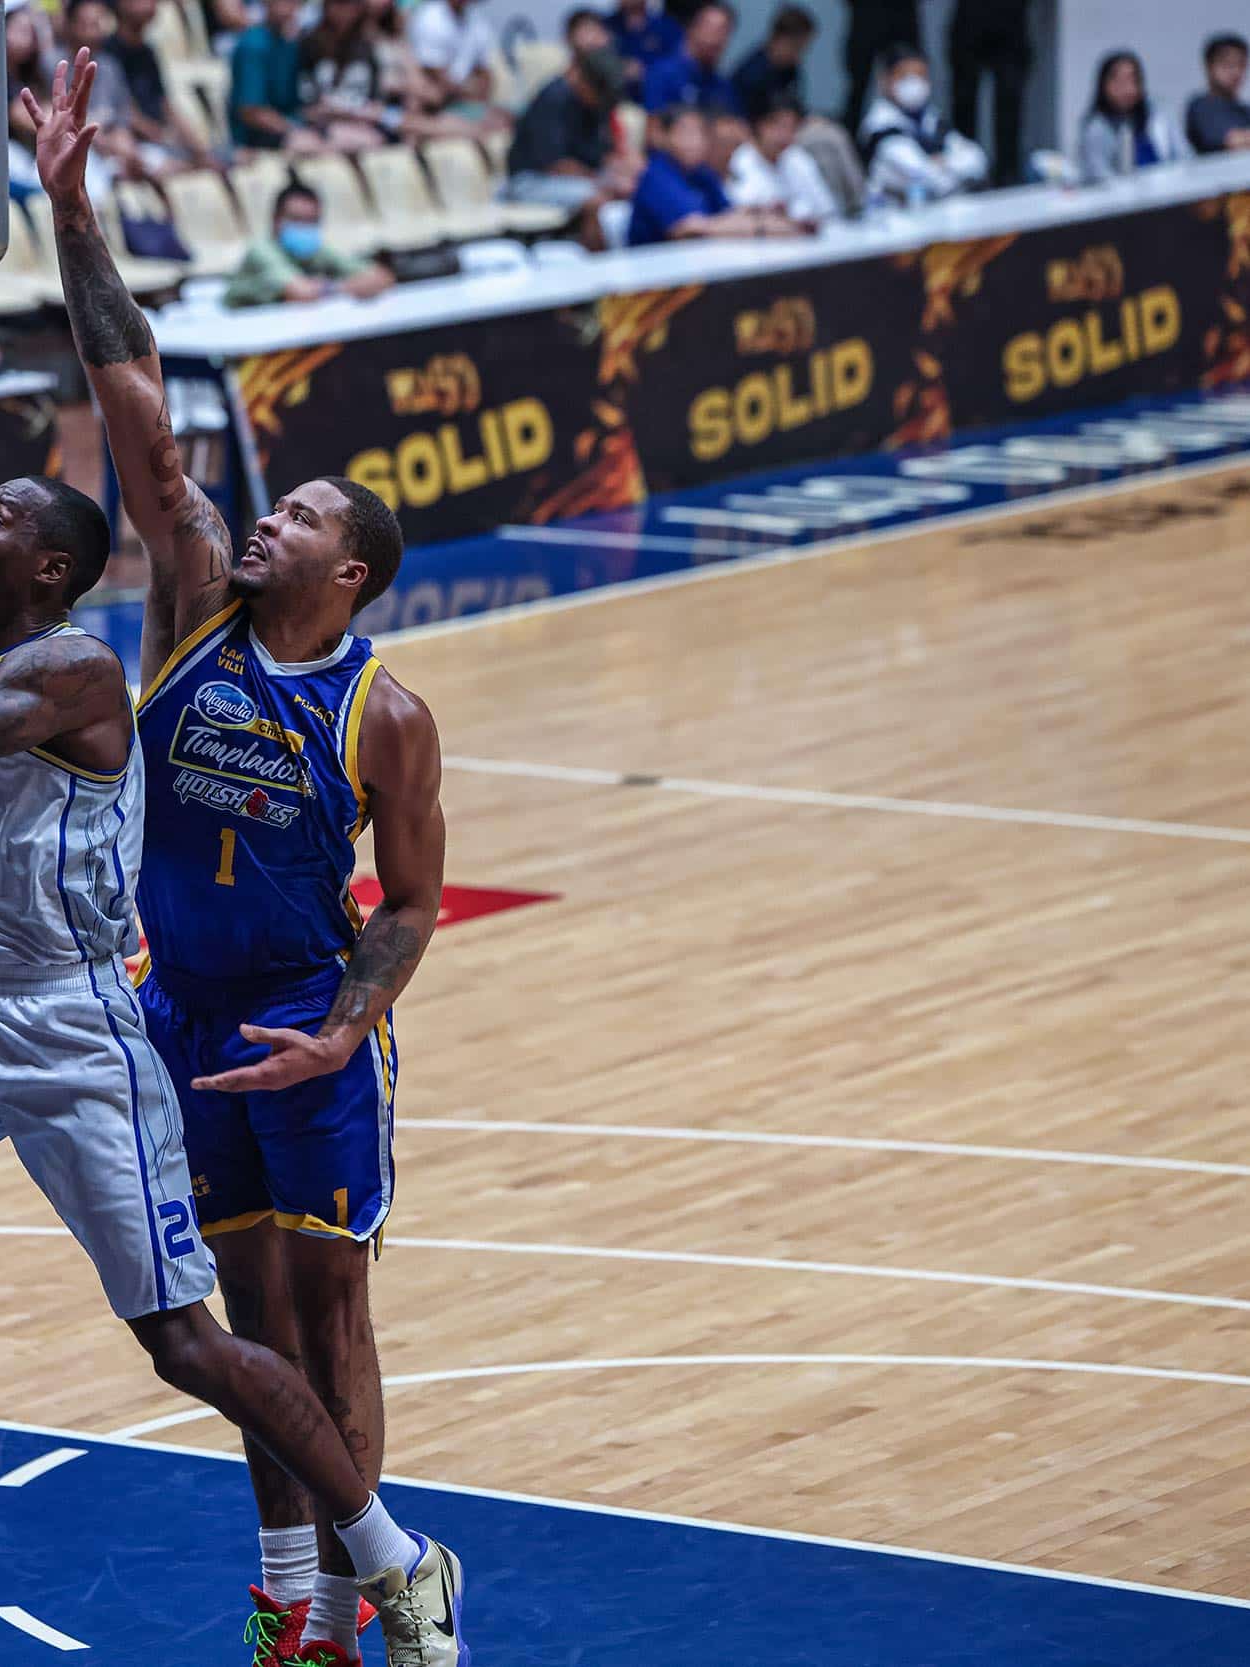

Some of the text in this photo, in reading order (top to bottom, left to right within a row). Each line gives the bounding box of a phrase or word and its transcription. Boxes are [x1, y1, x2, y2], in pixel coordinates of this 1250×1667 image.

[1003, 284, 1182, 403] SOLID
[688, 335, 873, 462] SOLID
[200, 687, 252, 722] Magnolia
[183, 726, 299, 782] Timplados
[215, 827, 236, 886] 1
[156, 1194, 200, 1260] 2
